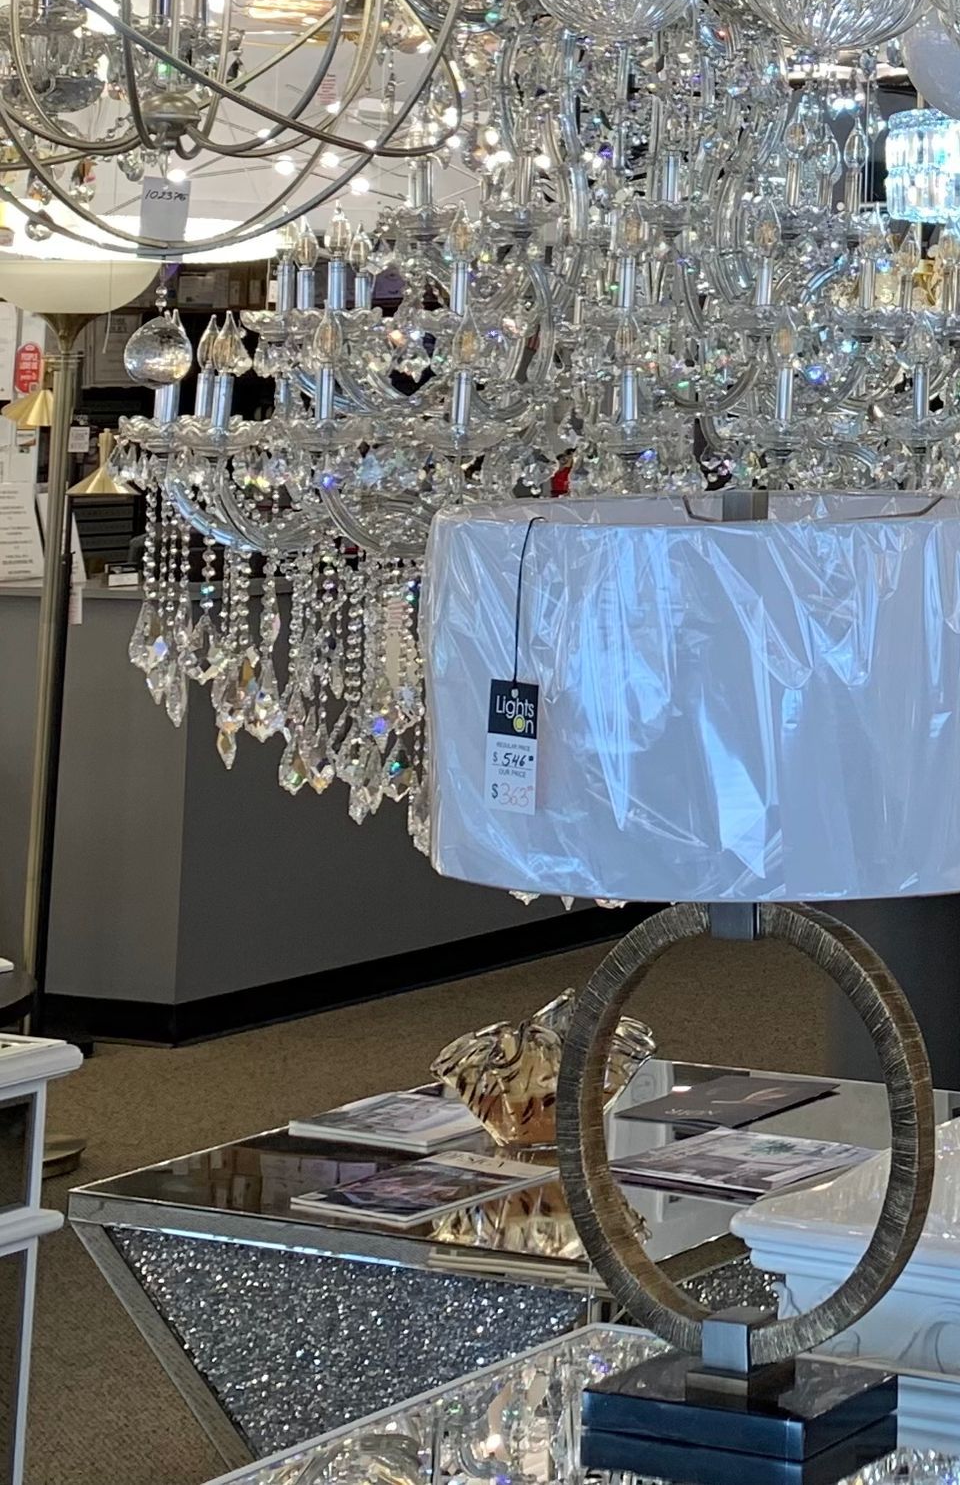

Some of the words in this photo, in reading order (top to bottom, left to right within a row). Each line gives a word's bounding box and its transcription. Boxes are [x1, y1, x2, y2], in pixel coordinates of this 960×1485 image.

[496, 695, 535, 719] Lights
[513, 715, 534, 734] On
[499, 768, 510, 776] OUR
[511, 770, 527, 779] PRICE
